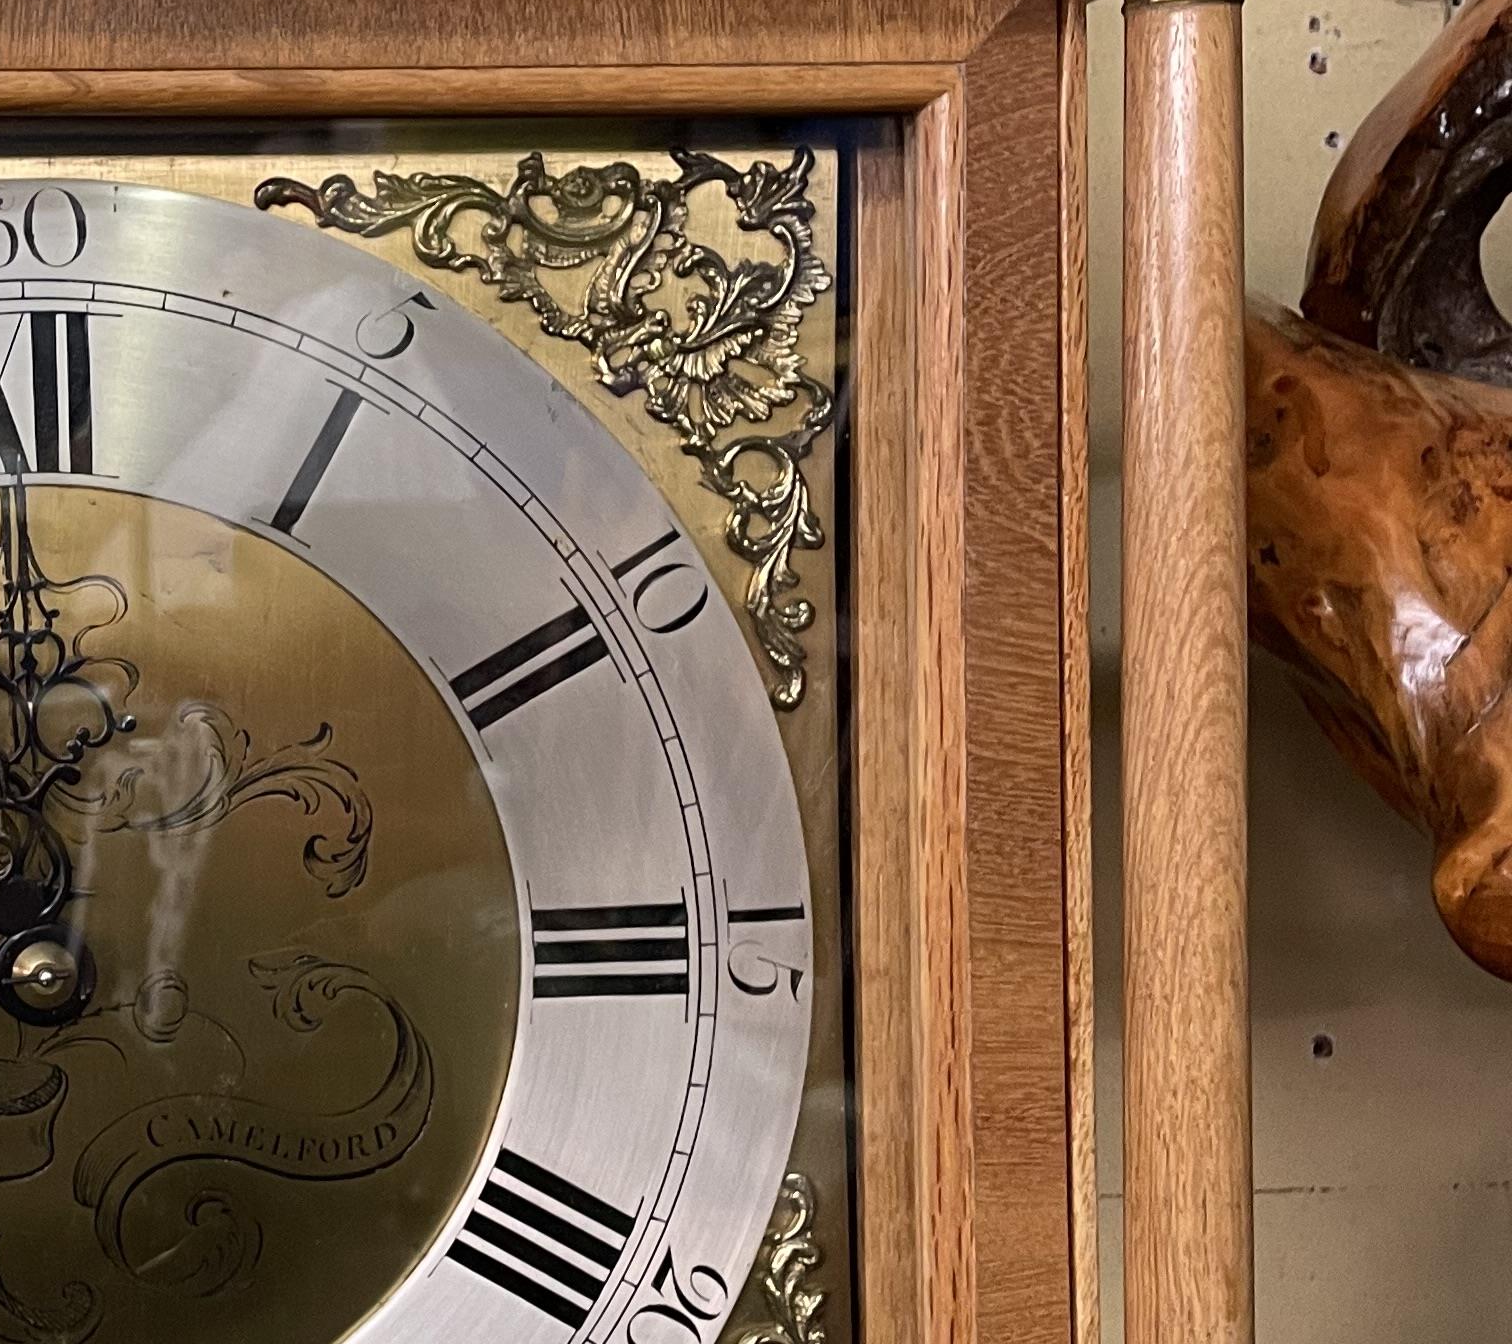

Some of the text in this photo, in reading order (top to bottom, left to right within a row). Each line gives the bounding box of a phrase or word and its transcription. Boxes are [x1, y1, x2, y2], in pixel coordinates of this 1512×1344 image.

[356, 292, 438, 359] 5
[251, 379, 391, 549] I
[597, 522, 709, 634] 10
[429, 577, 627, 762] II
[526, 880, 690, 1025] III
[723, 878, 806, 1003] 15
[146, 1114, 398, 1163] CAMELFORD
